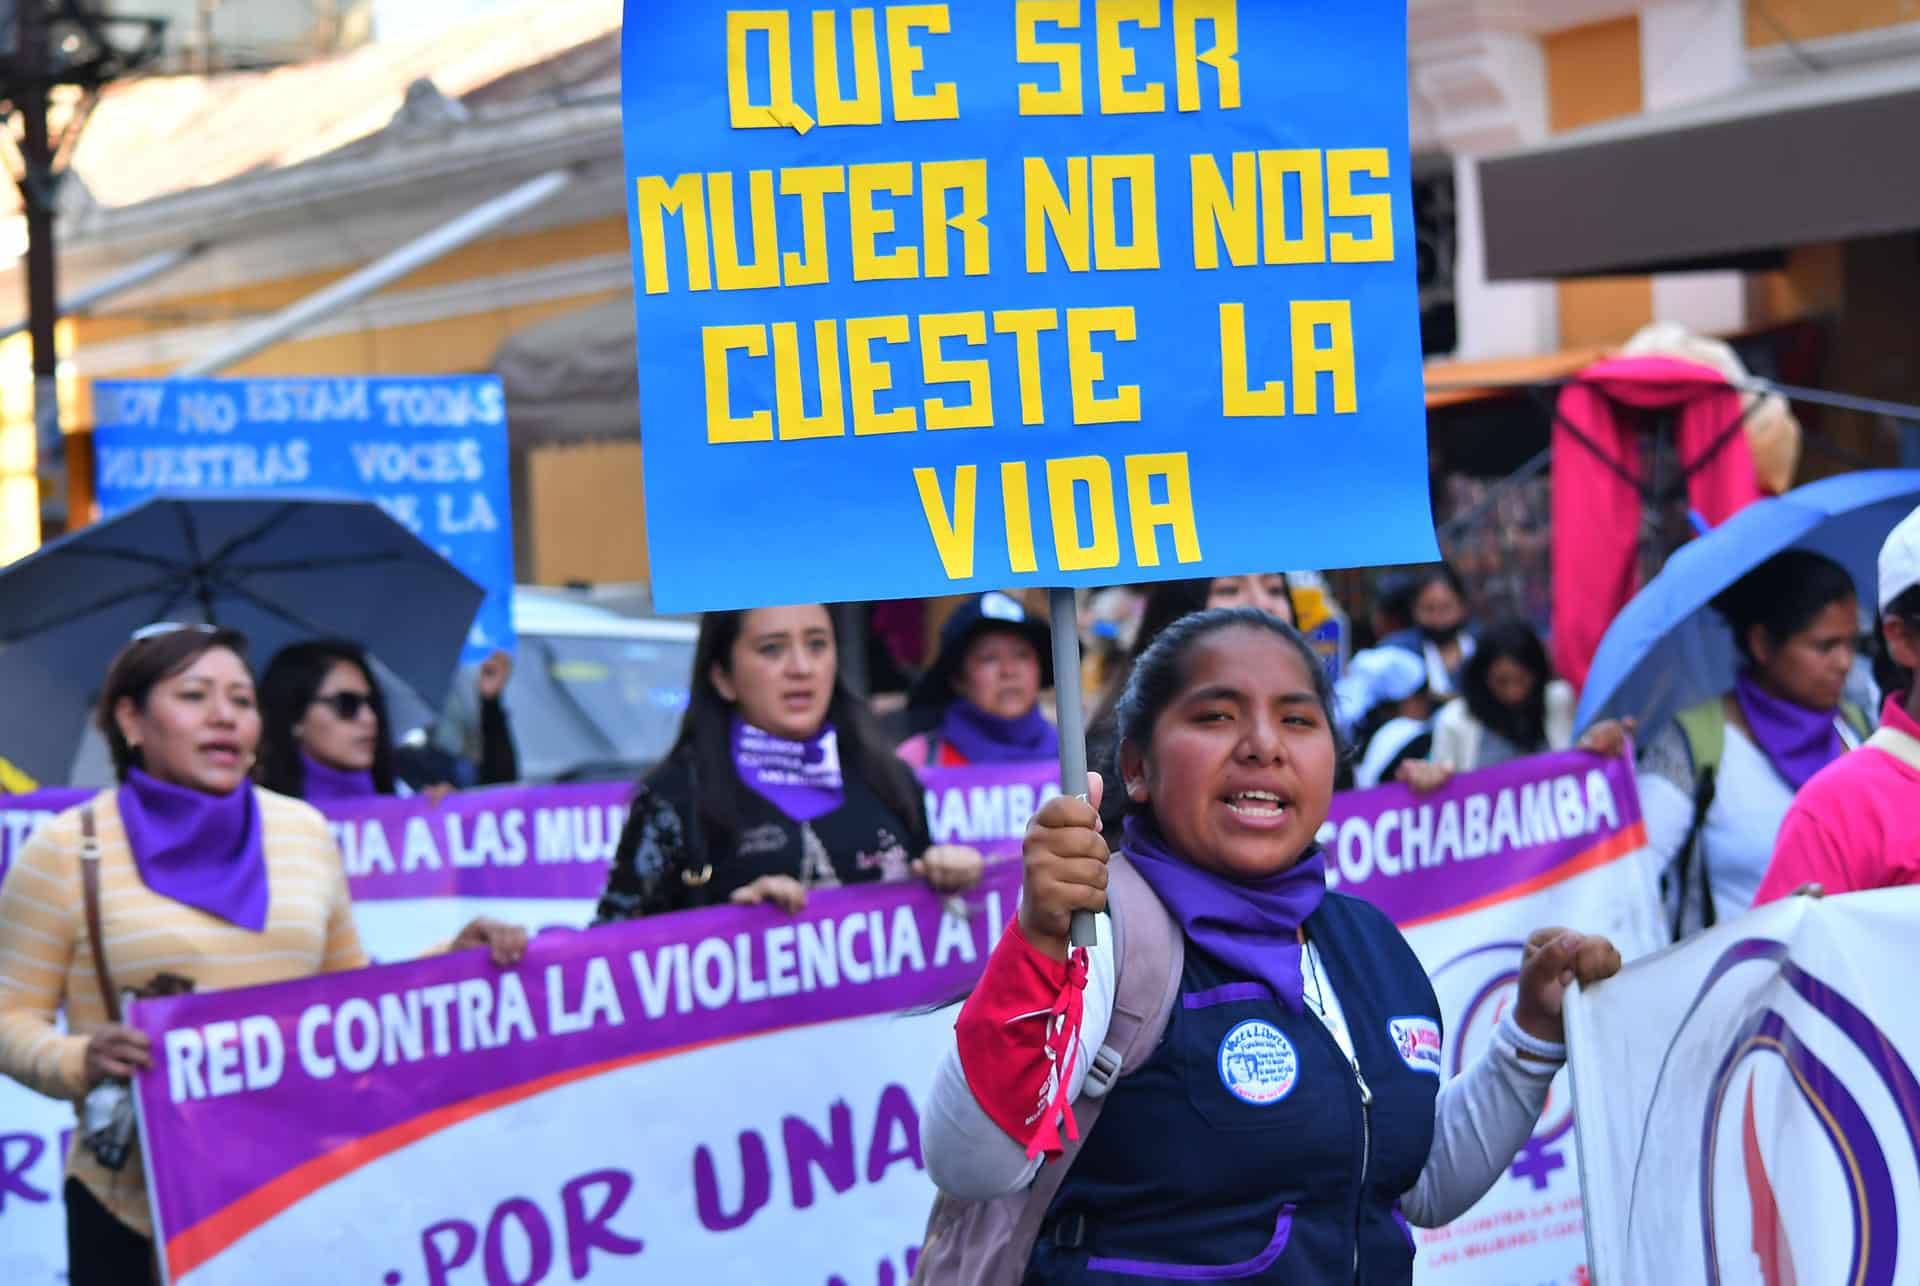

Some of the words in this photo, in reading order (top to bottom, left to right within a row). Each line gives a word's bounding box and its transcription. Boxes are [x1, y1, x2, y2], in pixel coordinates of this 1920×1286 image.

[728, 5, 958, 134] QUE
[1016, 0, 1240, 115] SER
[637, 159, 989, 294] MUJER
[1024, 155, 1160, 273] NO
[1191, 149, 1394, 269] NOS
[177, 394, 237, 433] NO
[380, 383, 500, 427] TODAS
[703, 307, 1140, 443] CUESTE
[1220, 301, 1357, 417] LA
[351, 440, 482, 481] VOCES
[438, 494, 496, 532] LA
[914, 453, 1201, 579] VIDA
[402, 816, 443, 872] A
[444, 808, 527, 867] LAS
[165, 1014, 285, 1104] RED
[299, 972, 537, 1079] CONTRA
[545, 956, 625, 1036] LA
[630, 905, 925, 1019] VIOLENCIA
[693, 1083, 924, 1232] UNA
